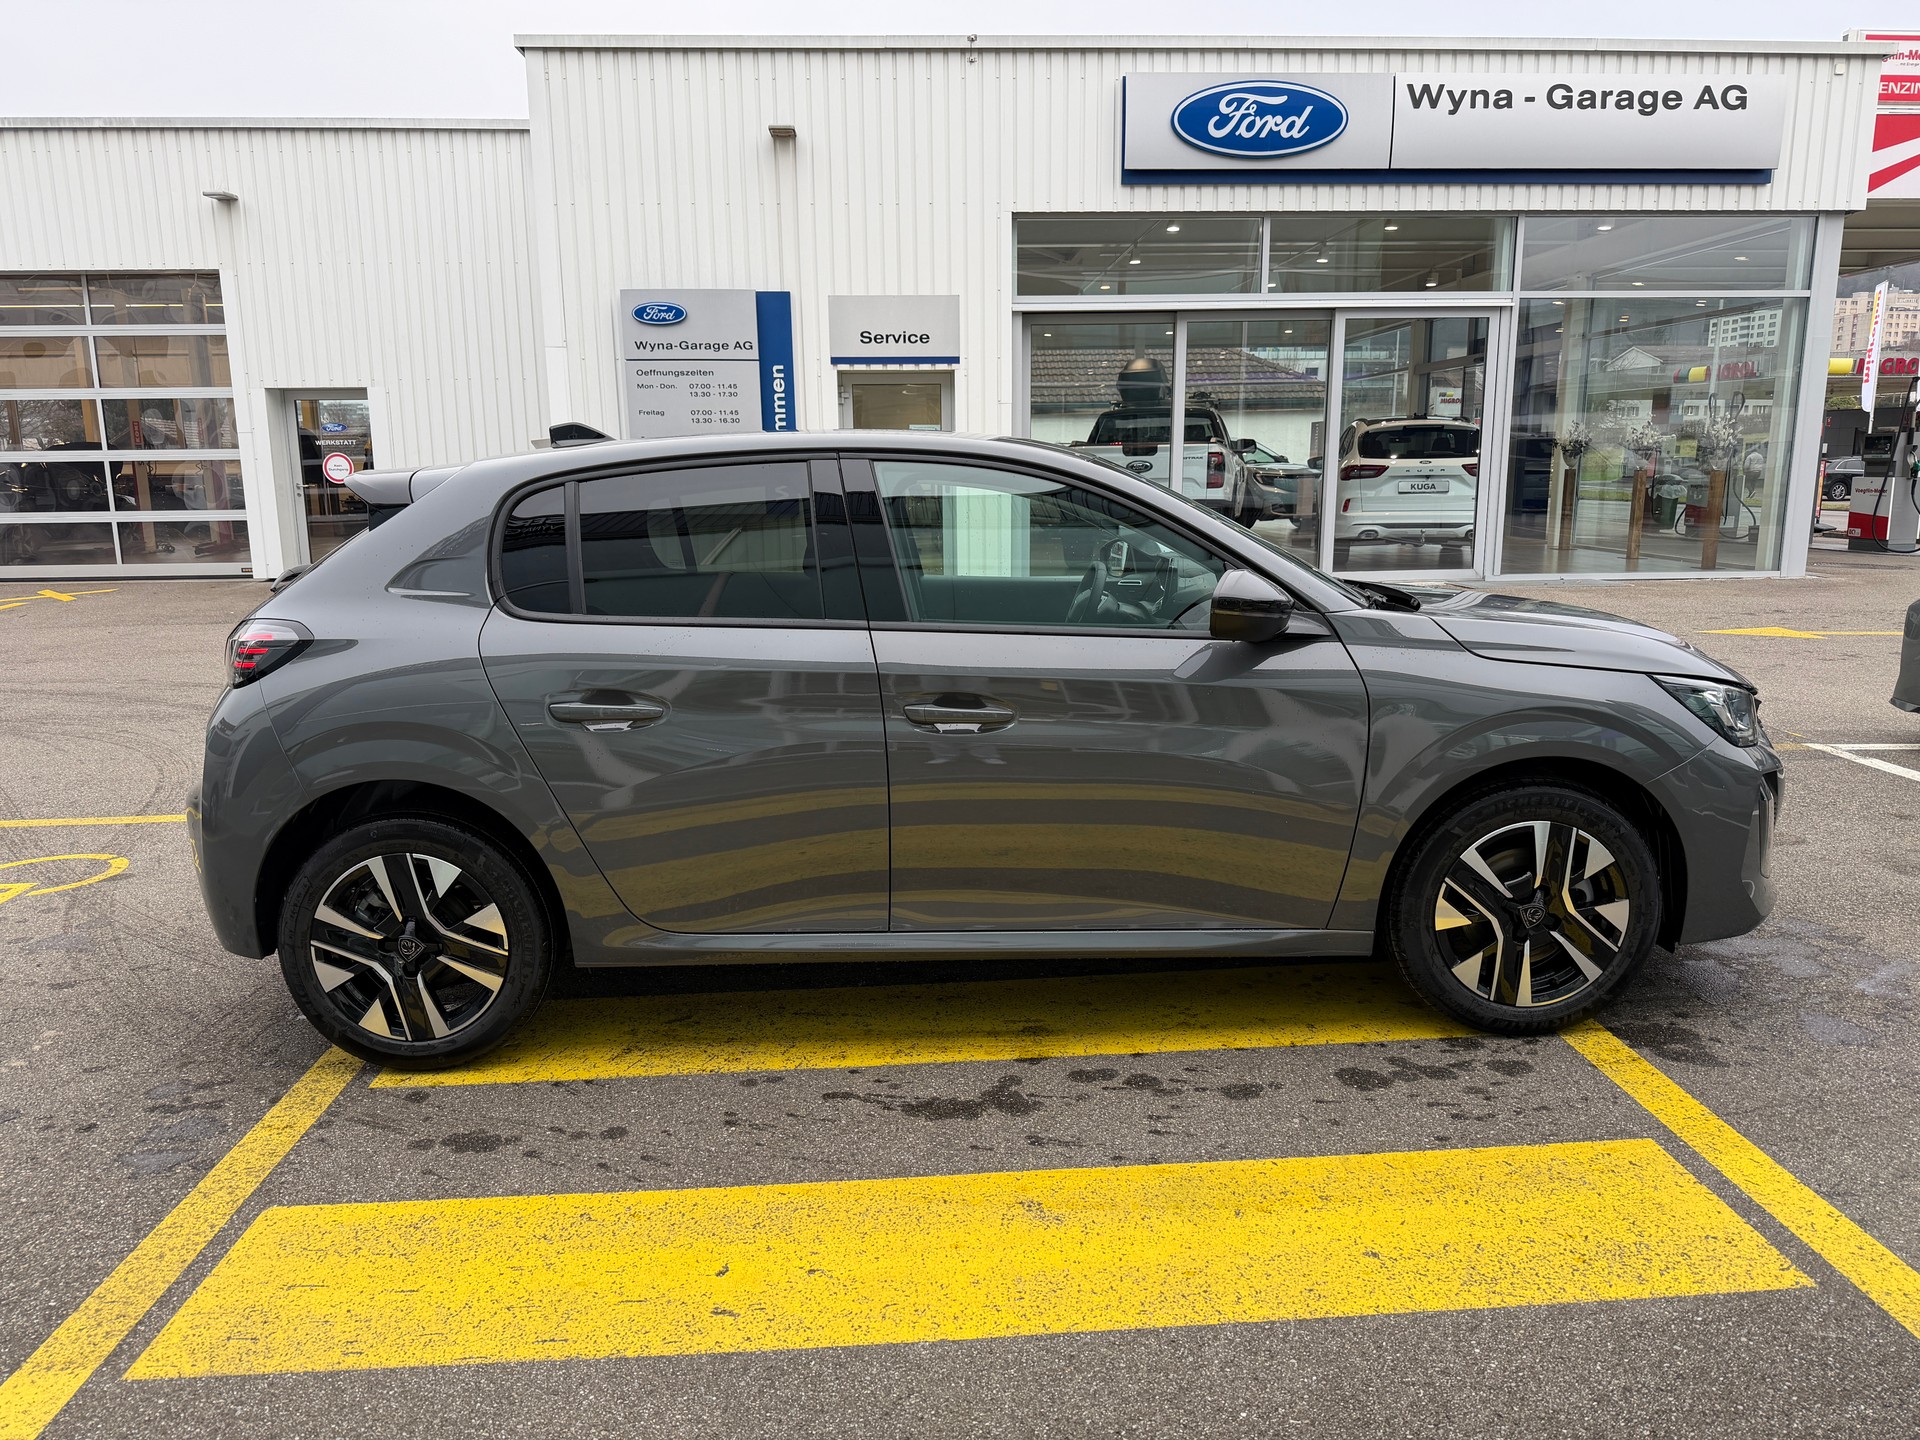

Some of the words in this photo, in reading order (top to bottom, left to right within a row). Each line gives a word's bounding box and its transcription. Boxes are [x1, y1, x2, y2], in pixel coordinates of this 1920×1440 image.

[1406, 83, 1513, 116] Wyna
[1546, 83, 1683, 117] Garage
[1693, 84, 1748, 111] AG
[1206, 92, 1314, 139] Ford
[643, 305, 676, 321] Ford
[859, 330, 931, 345] Service
[634, 340, 730, 353] Wyna-Garage
[733, 340, 754, 351] AG
[635, 368, 715, 378] Oeffnungszeiten
[1855, 357, 1920, 374] MGRO
[638, 409, 665, 417] Freitag
[1410, 483, 1437, 491] KUGA
